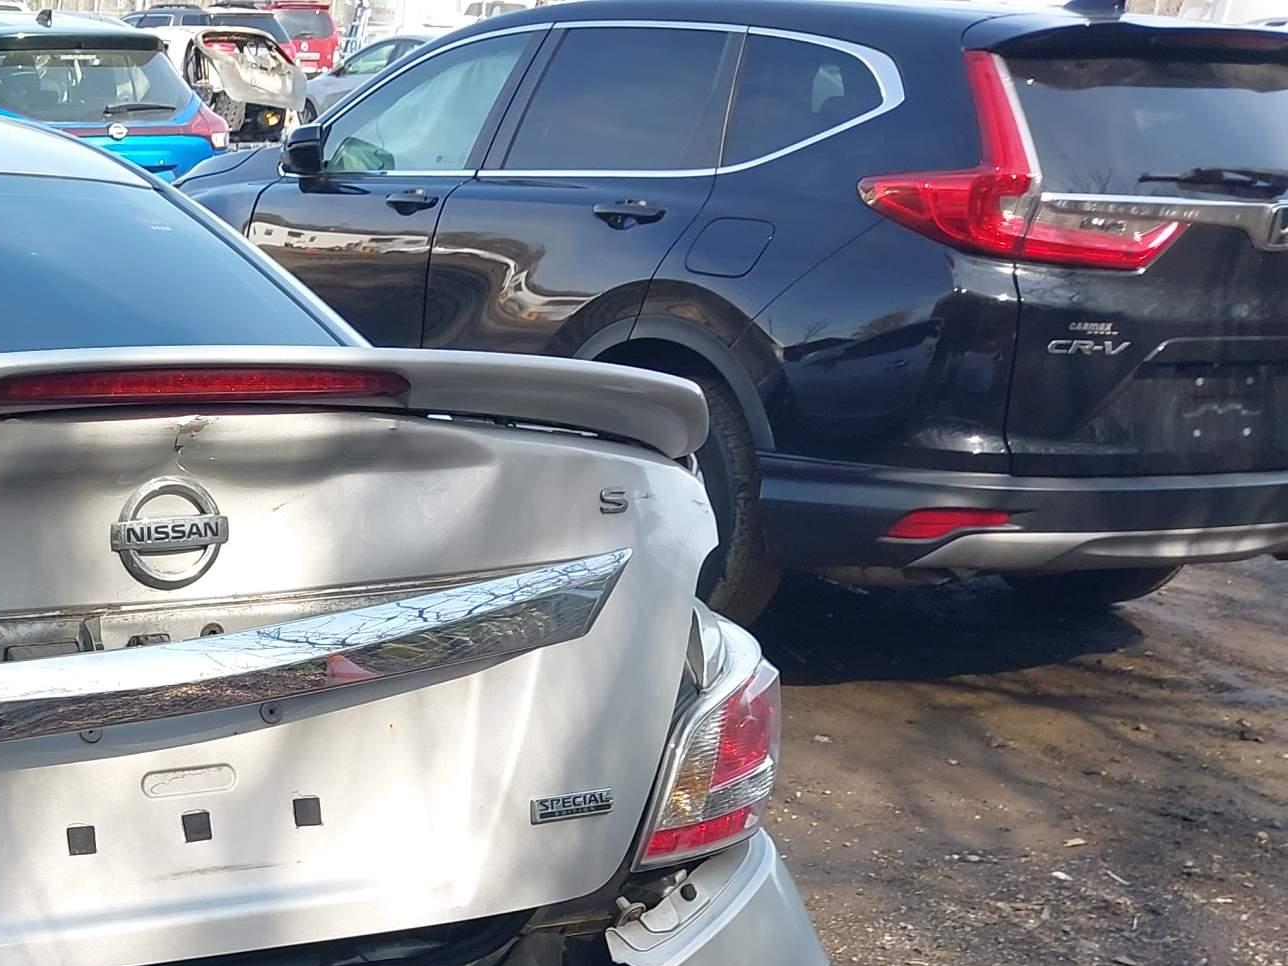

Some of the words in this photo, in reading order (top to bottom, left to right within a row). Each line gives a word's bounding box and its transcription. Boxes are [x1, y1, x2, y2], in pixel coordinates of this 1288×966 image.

[1047, 339, 1132, 355] CR-V
[599, 487, 629, 514] S
[126, 521, 219, 544] NISSAN
[539, 792, 610, 812] SPECIAL
